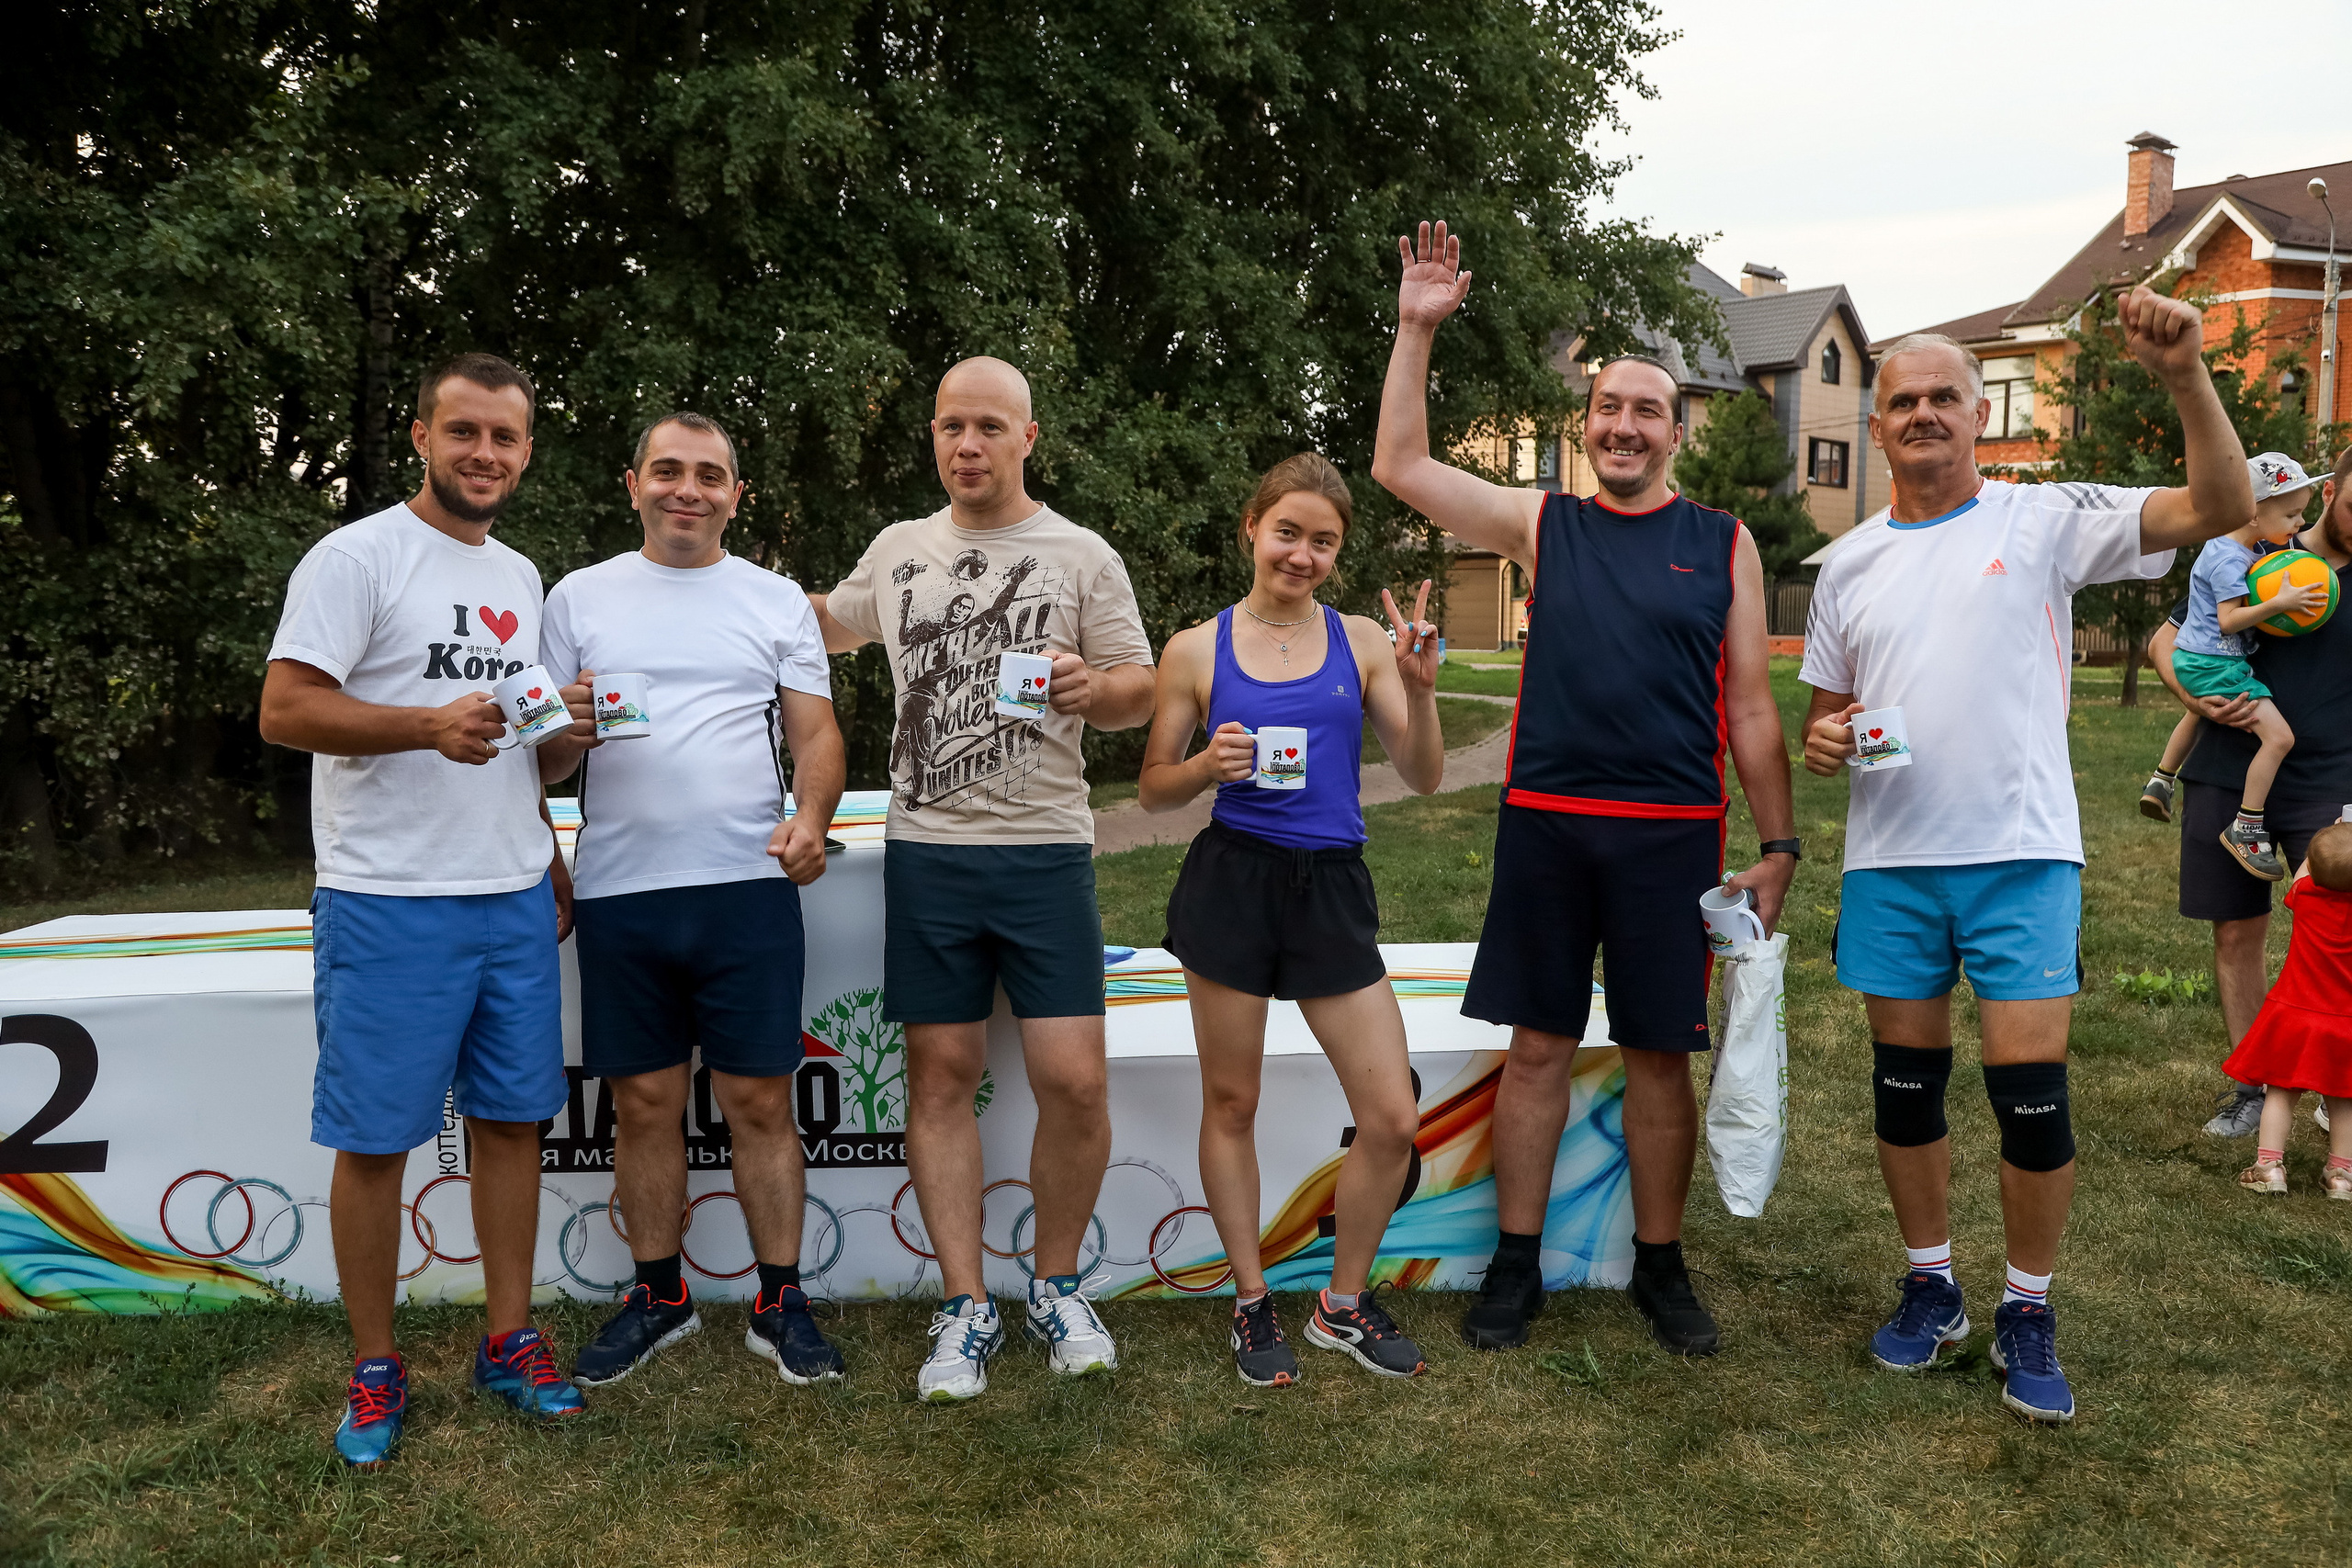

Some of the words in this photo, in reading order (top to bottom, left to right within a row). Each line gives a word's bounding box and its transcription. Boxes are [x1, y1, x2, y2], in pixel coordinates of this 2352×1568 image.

[1982, 567, 2007, 576] adidas
[453, 604, 470, 637] I
[983, 602, 1052, 655] ALL
[467, 645, 502, 656] 대한민국
[423, 643, 534, 681] Kore
[1021, 678, 1032, 690] Я
[515, 695, 529, 711] Я
[597, 696, 605, 708] Я
[1859, 732, 1868, 744] Я
[1272, 750, 1282, 761] Я
[926, 747, 1002, 798] UNITES
[0, 1013, 109, 1174] 2
